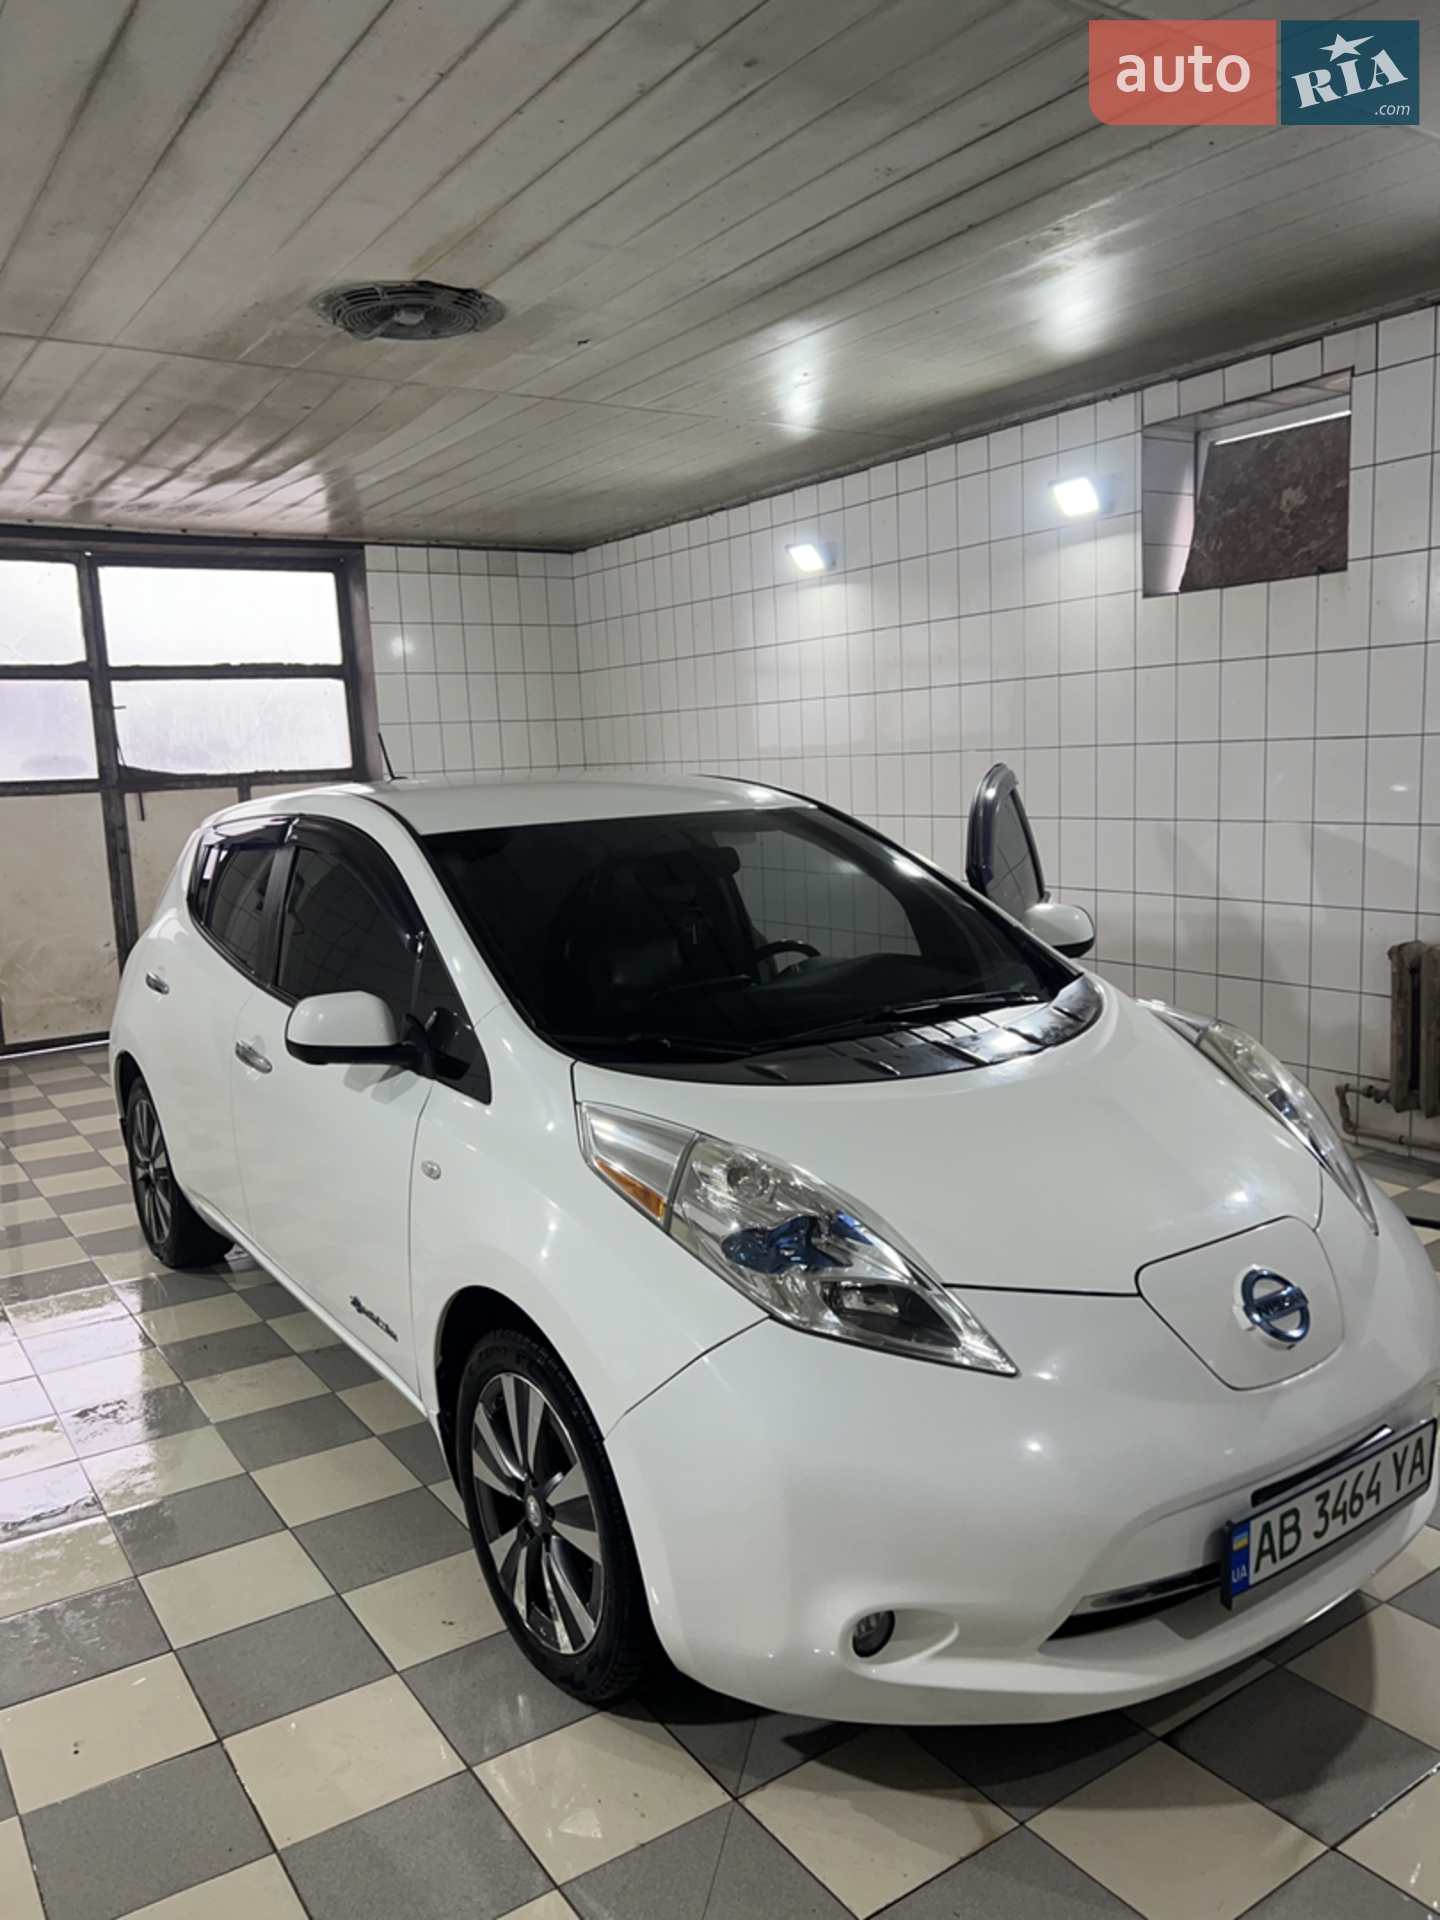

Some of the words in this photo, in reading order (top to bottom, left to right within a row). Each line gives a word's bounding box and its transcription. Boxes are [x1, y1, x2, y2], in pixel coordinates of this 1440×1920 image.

[1254, 1507, 1302, 1574] AB
[1313, 1460, 1381, 1540] 3464
[1393, 1436, 1425, 1493] YA
[1231, 1564, 1248, 1584] UA
